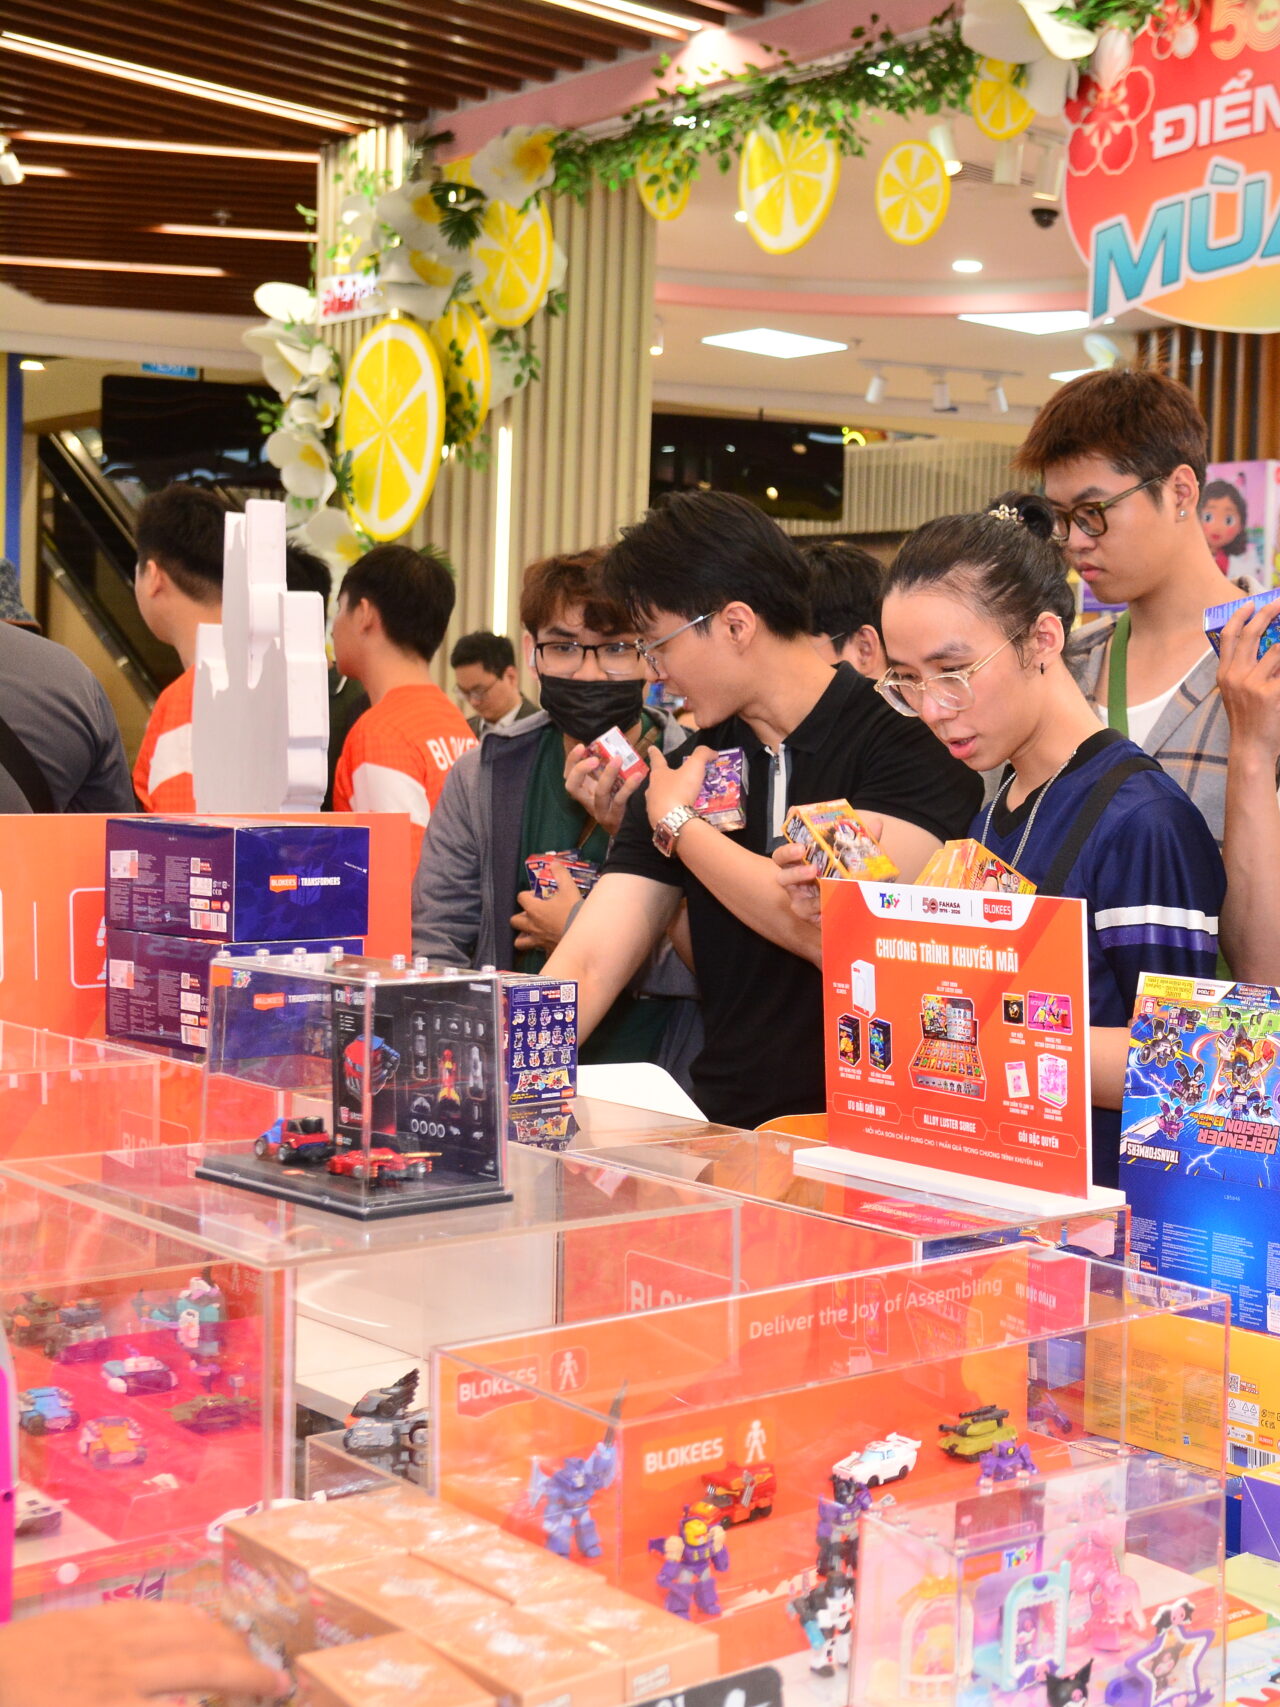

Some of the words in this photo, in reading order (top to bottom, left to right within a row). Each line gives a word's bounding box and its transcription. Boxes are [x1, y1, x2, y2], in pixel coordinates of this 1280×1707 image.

[939, 901, 961, 909] FAHASA
[984, 903, 1012, 916] BLOKEES
[876, 938, 917, 961] CHƯƠNG
[919, 939, 950, 965] TRÌNH
[952, 945, 993, 970] KHUYẾN
[996, 947, 1019, 973] MÃI
[924, 1114, 939, 1128] ALLOY
[940, 1116, 959, 1131] LUSTER
[959, 1120, 976, 1134] SURGE
[1213, 1116, 1224, 1127] 03
[1224, 1119, 1280, 1140] VERSION
[924, 1139, 935, 1147] CHO
[963, 1146, 978, 1155] TRONG
[1197, 1128, 1277, 1155] DEFENDER
[1127, 1143, 1179, 1164] TRANSFORMERS
[749, 1313, 814, 1340] Deliver
[818, 1304, 848, 1325] the
[851, 1300, 879, 1324] Joy
[884, 1296, 902, 1314] of
[906, 1278, 1003, 1308] Assembling
[458, 1367, 537, 1402] BLOKEES
[644, 1437, 724, 1476] BLOKEES
